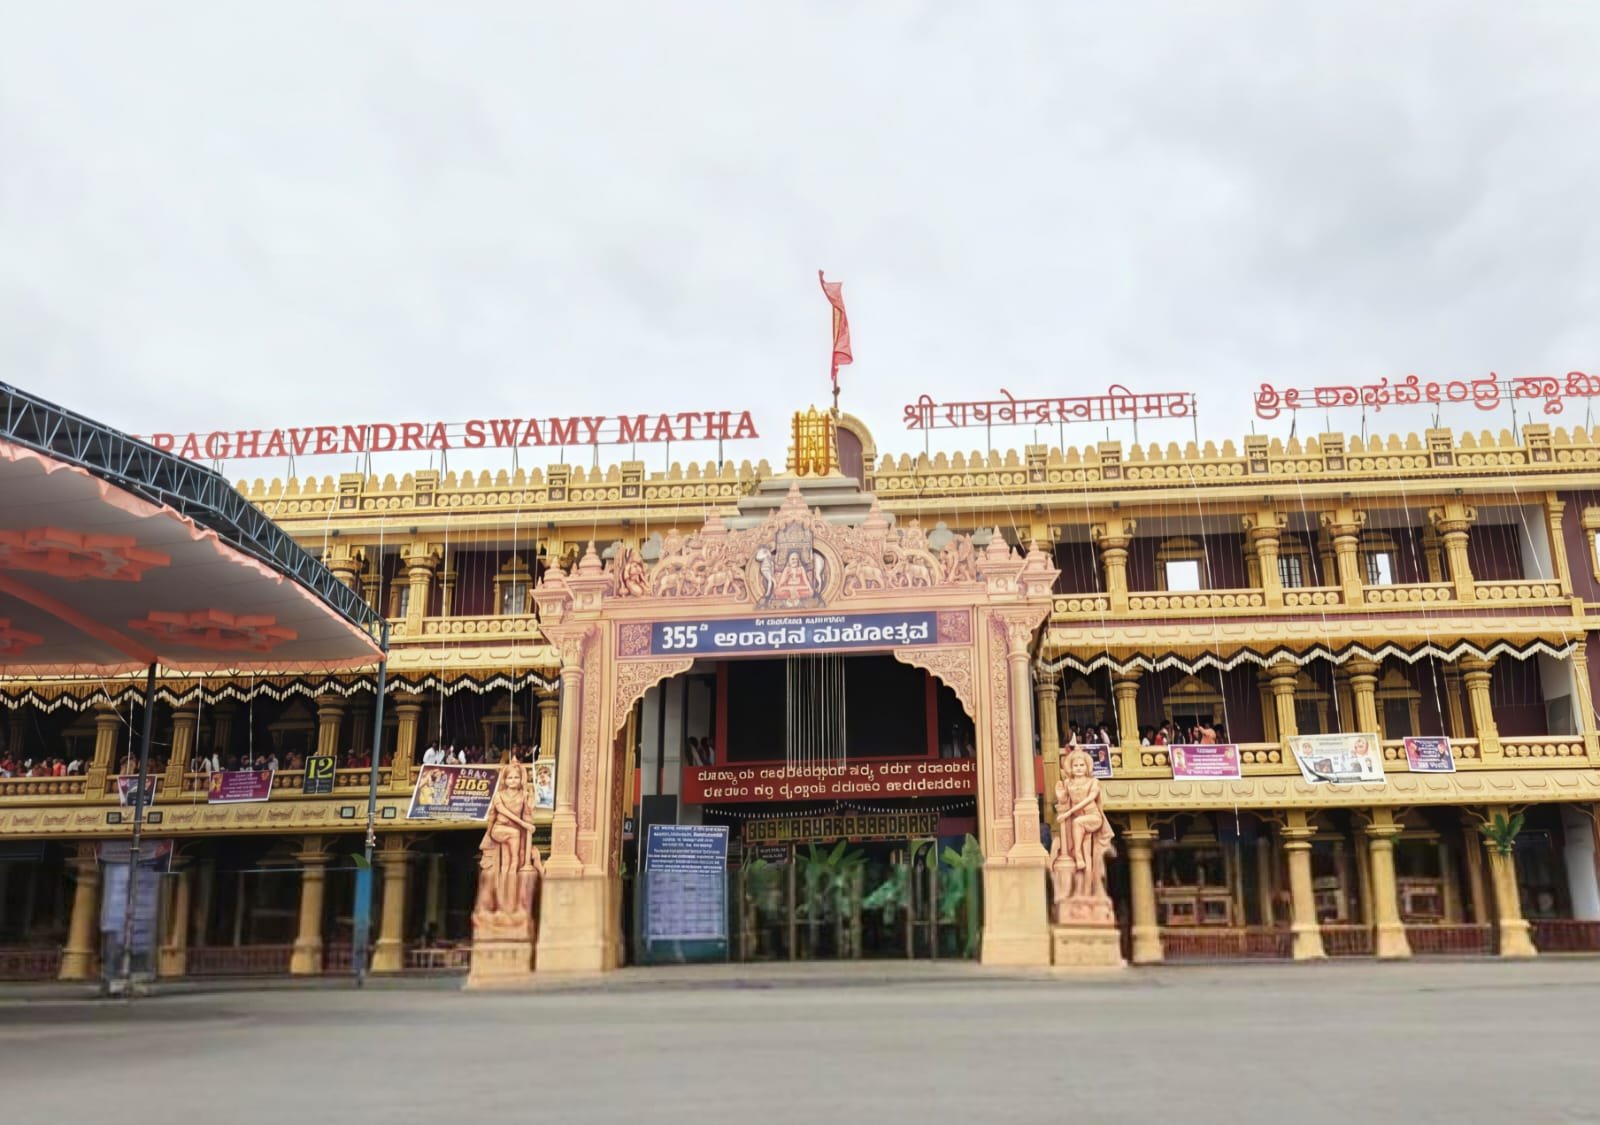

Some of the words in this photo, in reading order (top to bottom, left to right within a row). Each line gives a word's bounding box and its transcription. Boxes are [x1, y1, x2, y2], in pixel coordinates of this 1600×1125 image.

[903, 394, 938, 430] श्री
[1255, 383, 1301, 419] ಶ್ರೀ
[153, 422, 450, 459] RAGHAVENDRA
[465, 416, 606, 448] SWAMY
[617, 410, 760, 443] MATHA
[308, 758, 333, 778] 12
